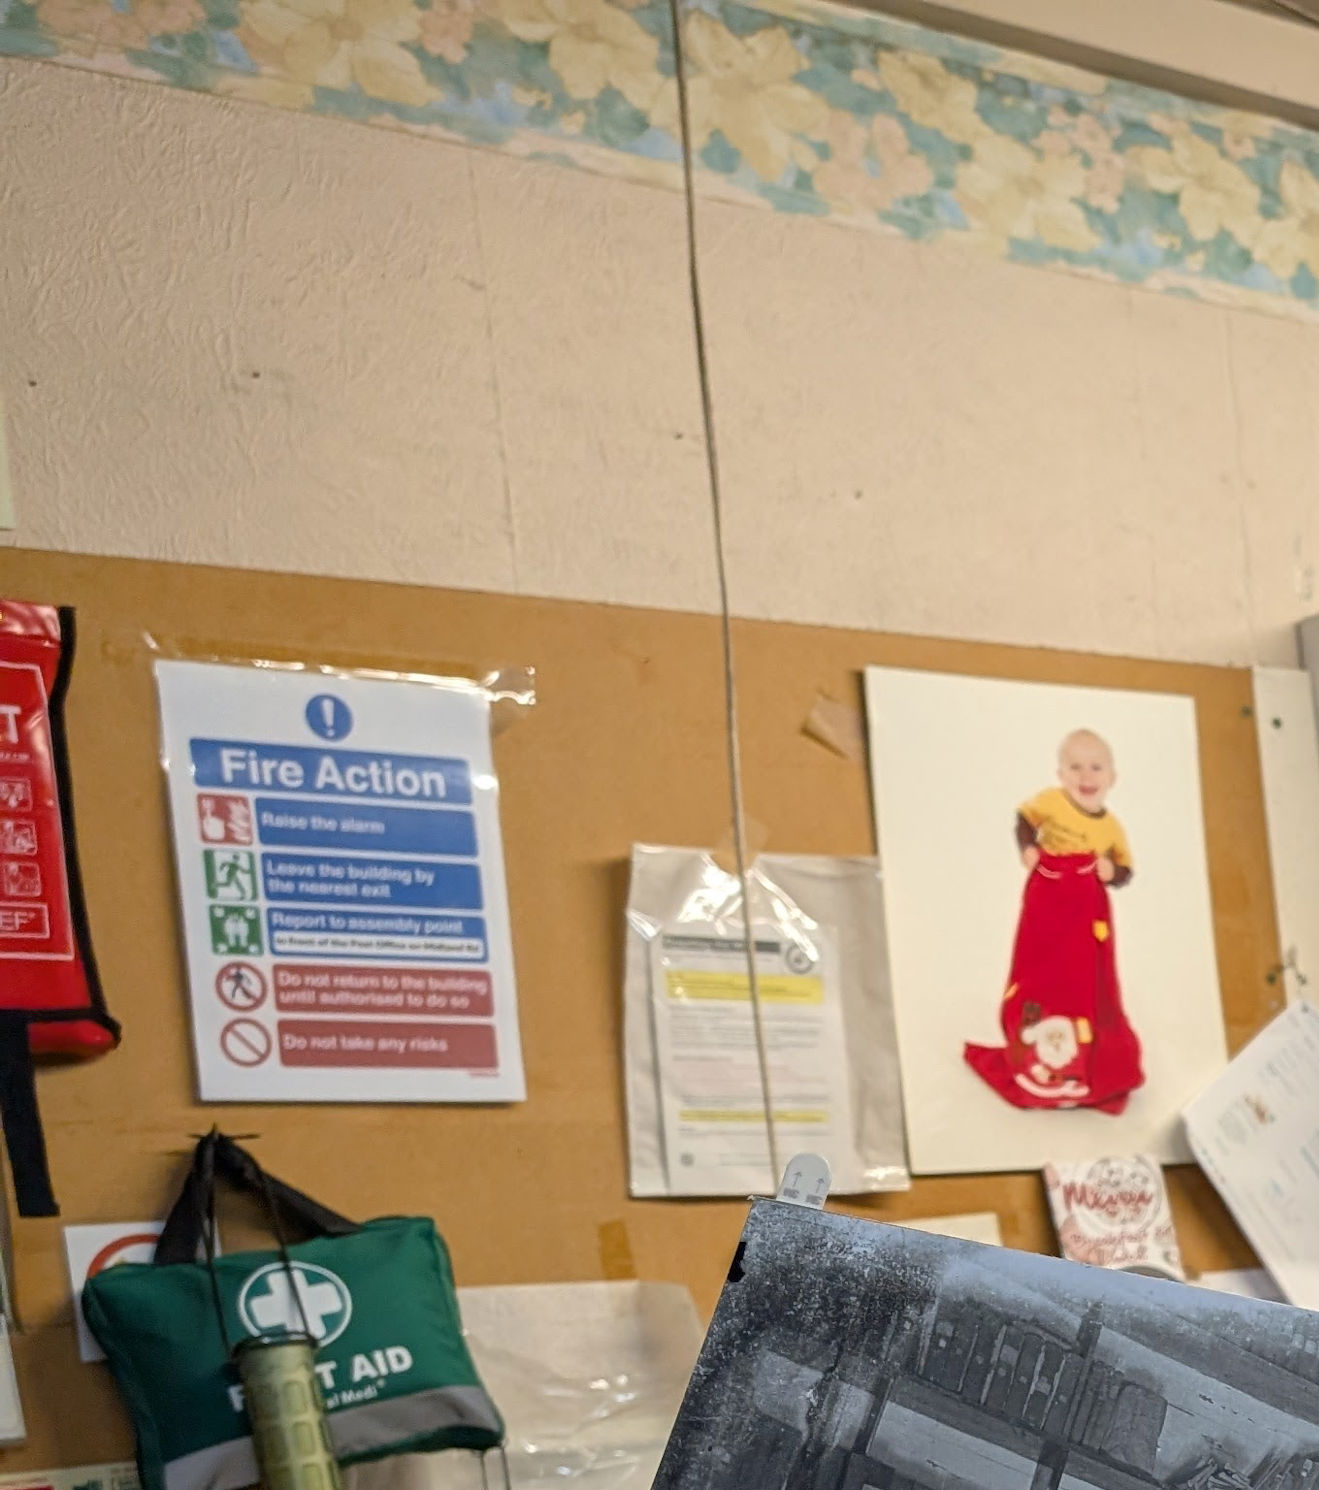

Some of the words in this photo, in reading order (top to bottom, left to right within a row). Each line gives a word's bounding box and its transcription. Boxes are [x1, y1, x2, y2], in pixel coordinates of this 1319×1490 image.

[220, 749, 304, 787] Fire
[315, 755, 447, 798] Action
[261, 812, 307, 830] Raise
[311, 815, 337, 832] the
[340, 818, 385, 835] alarm
[266, 859, 315, 878] Leave
[319, 862, 346, 879] the
[348, 864, 412, 884] building
[415, 867, 434, 885] by
[268, 875, 296, 893] the
[299, 879, 358, 897] nearest
[361, 883, 391, 899] exit
[271, 912, 326, 931] Report
[330, 913, 346, 929] to
[348, 916, 421, 934] assembly
[424, 920, 464, 936] point
[278, 971, 300, 987] Do
[304, 972, 331, 988] not
[333, 973, 380, 989] return
[382, 974, 399, 990] to
[401, 974, 426, 991] the
[428, 975, 488, 996] building
[279, 990, 316, 1005] until
[319, 991, 404, 1007] authorised
[406, 992, 424, 1008] to
[427, 992, 448, 1009] do
[451, 996, 470, 1009] so
[282, 1034, 307, 1050] Do
[310, 1035, 337, 1050] not
[340, 1035, 374, 1051] take
[377, 1038, 406, 1054] any
[409, 1037, 449, 1052] risks
[352, 1345, 413, 1382] AID
